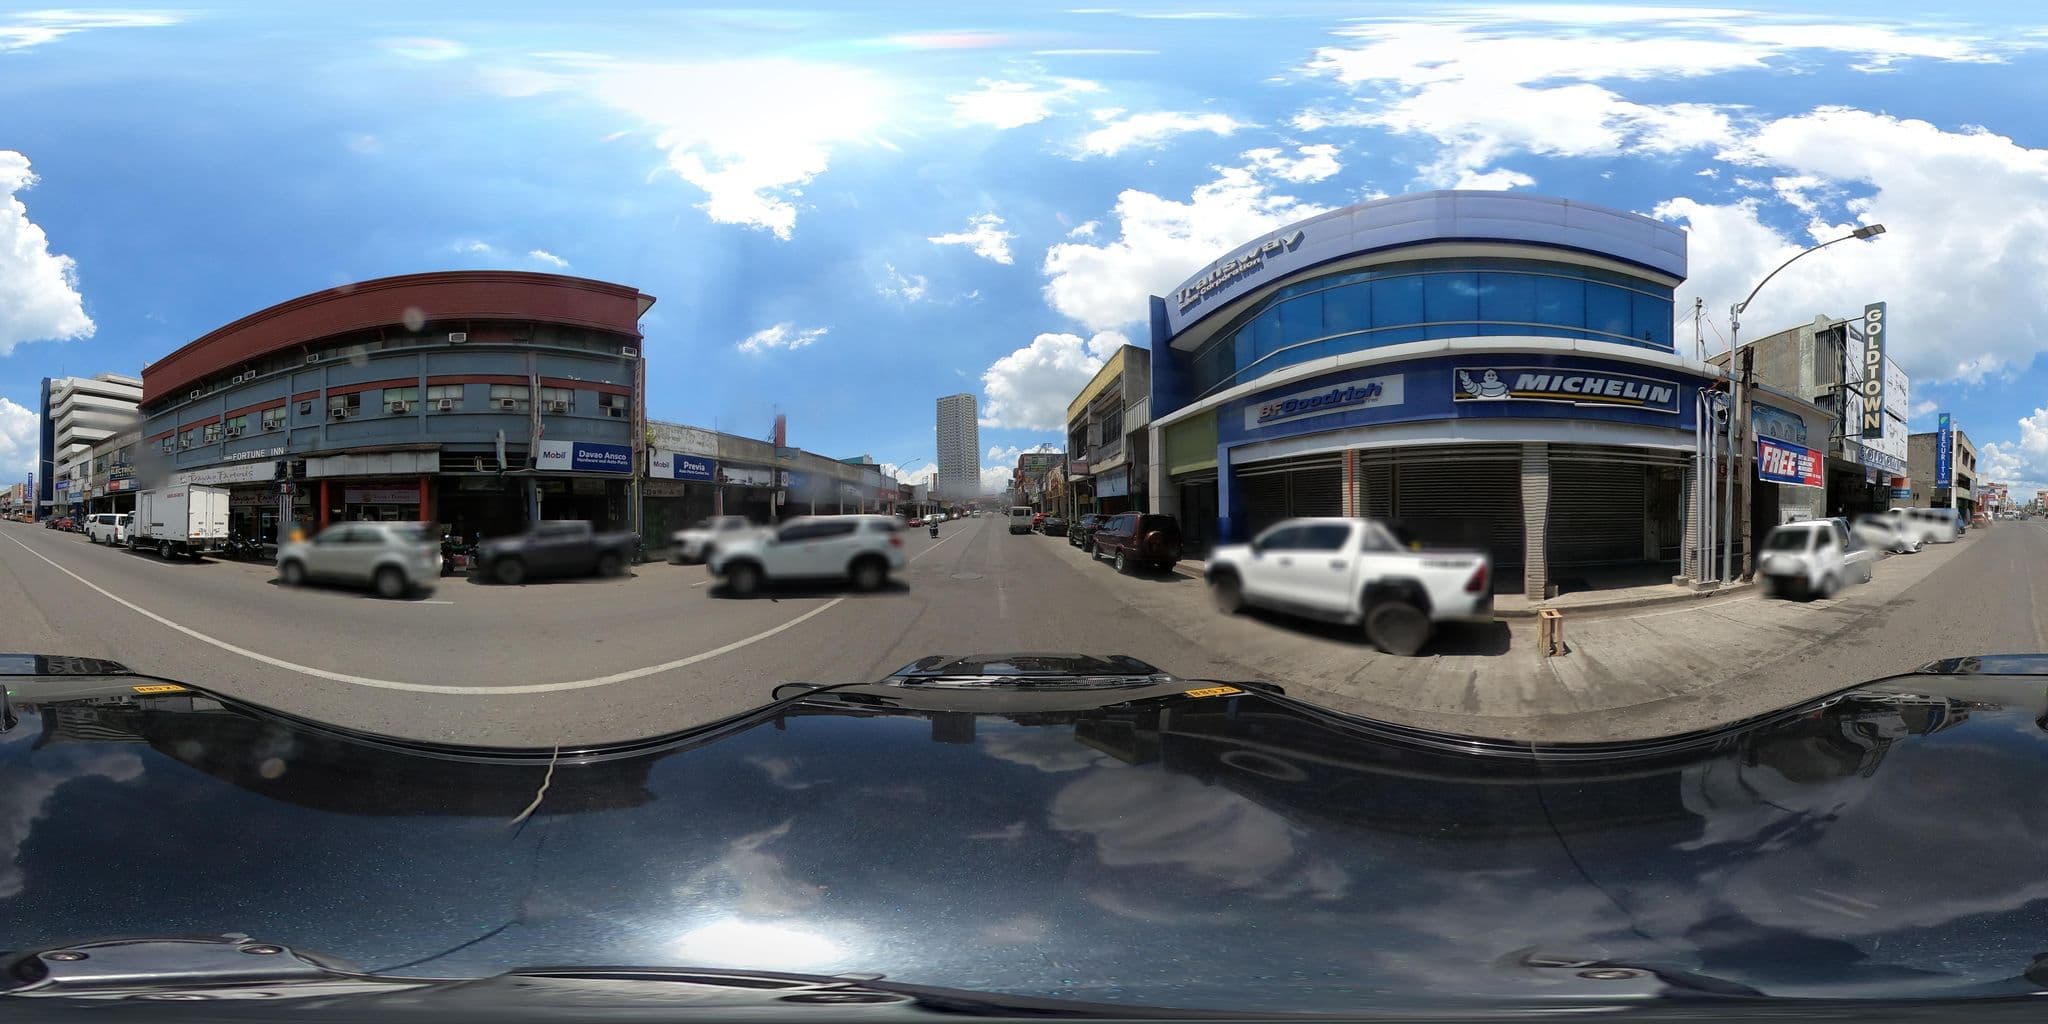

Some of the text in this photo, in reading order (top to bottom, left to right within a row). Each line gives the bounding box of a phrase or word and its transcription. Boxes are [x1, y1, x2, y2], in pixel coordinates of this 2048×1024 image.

[1176, 230, 1304, 304] Transway
[1200, 258, 1262, 295] Corporation
[1864, 308, 1883, 430] GOLDTOWN
[1260, 382, 1383, 418] BFGoodrich
[1514, 373, 1673, 404] MICHELIN
[232, 449, 265, 460] FORTUNE
[270, 447, 285, 456] INN
[543, 451, 566, 459] Mobil
[578, 450, 627, 461] Davao Ansco
[653, 461, 669, 469] Mobil
[683, 461, 706, 471] Previa
[1762, 446, 1798, 477] FREE
